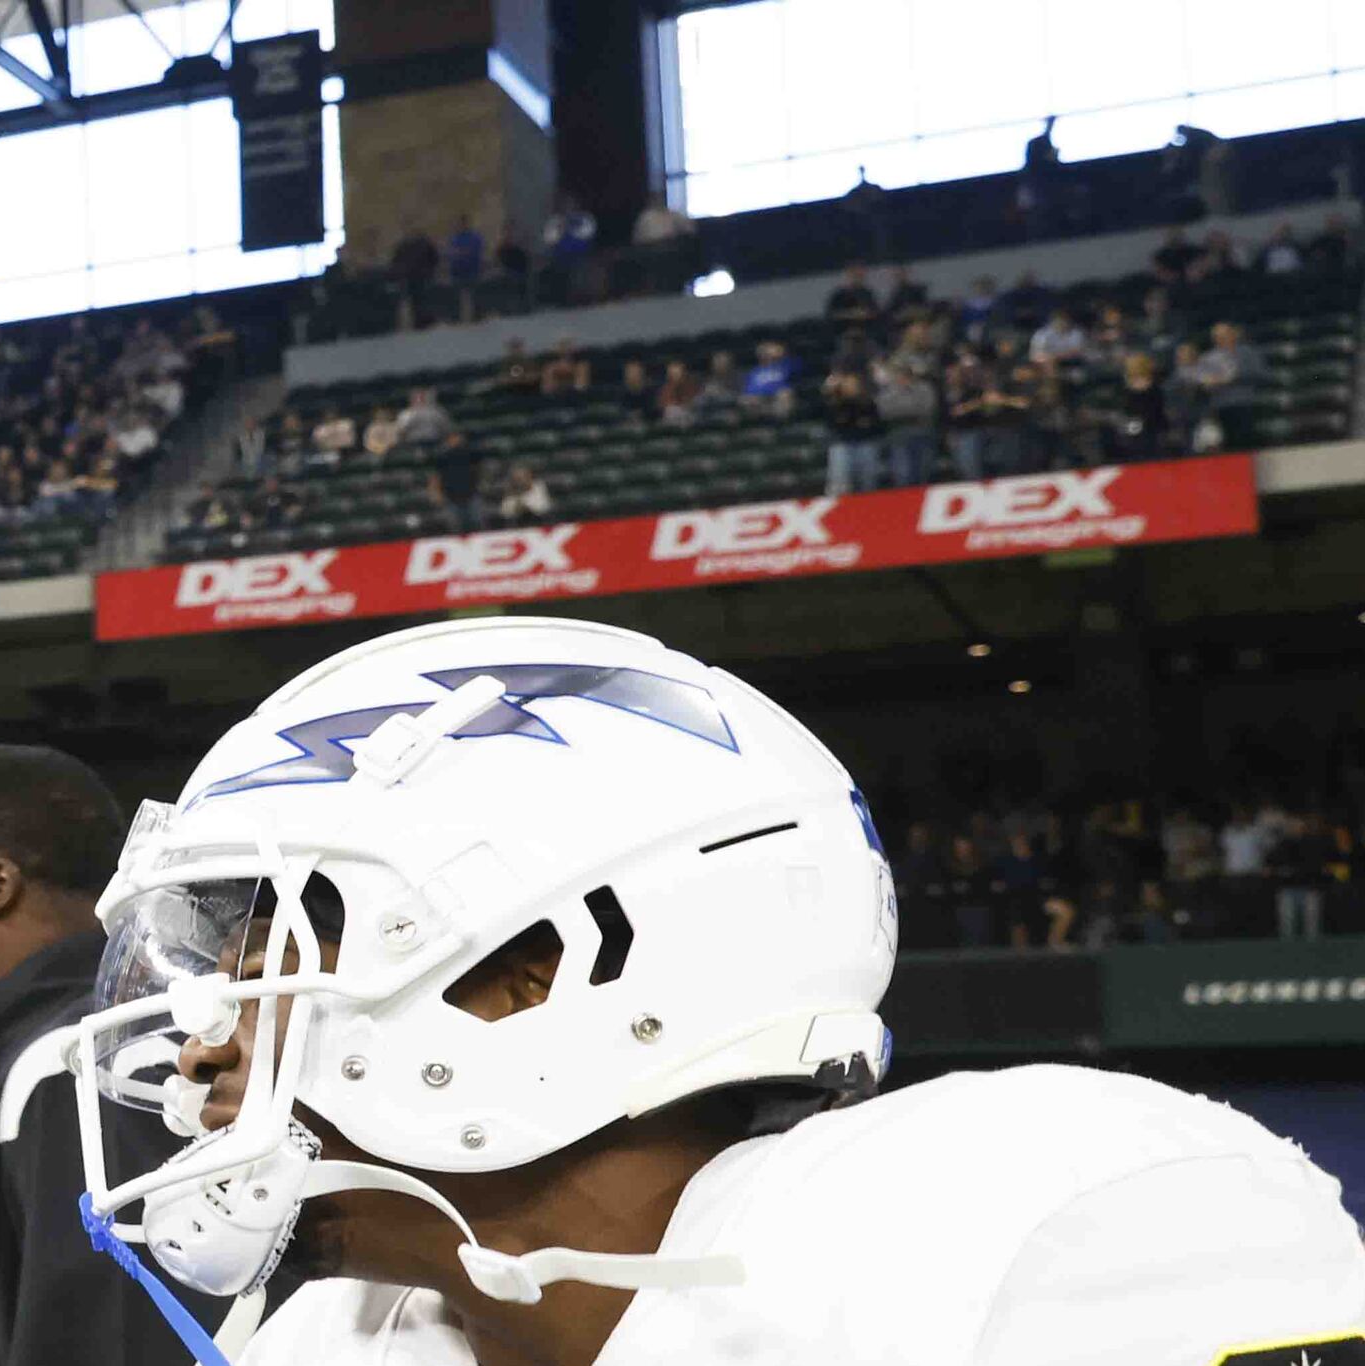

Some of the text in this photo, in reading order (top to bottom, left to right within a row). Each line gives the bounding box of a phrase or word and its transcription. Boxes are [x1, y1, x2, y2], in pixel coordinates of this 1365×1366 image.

[650, 497, 838, 561] DEX
[916, 466, 1122, 535] DEX
[174, 548, 338, 608] DEX
[403, 524, 581, 586] DEX
